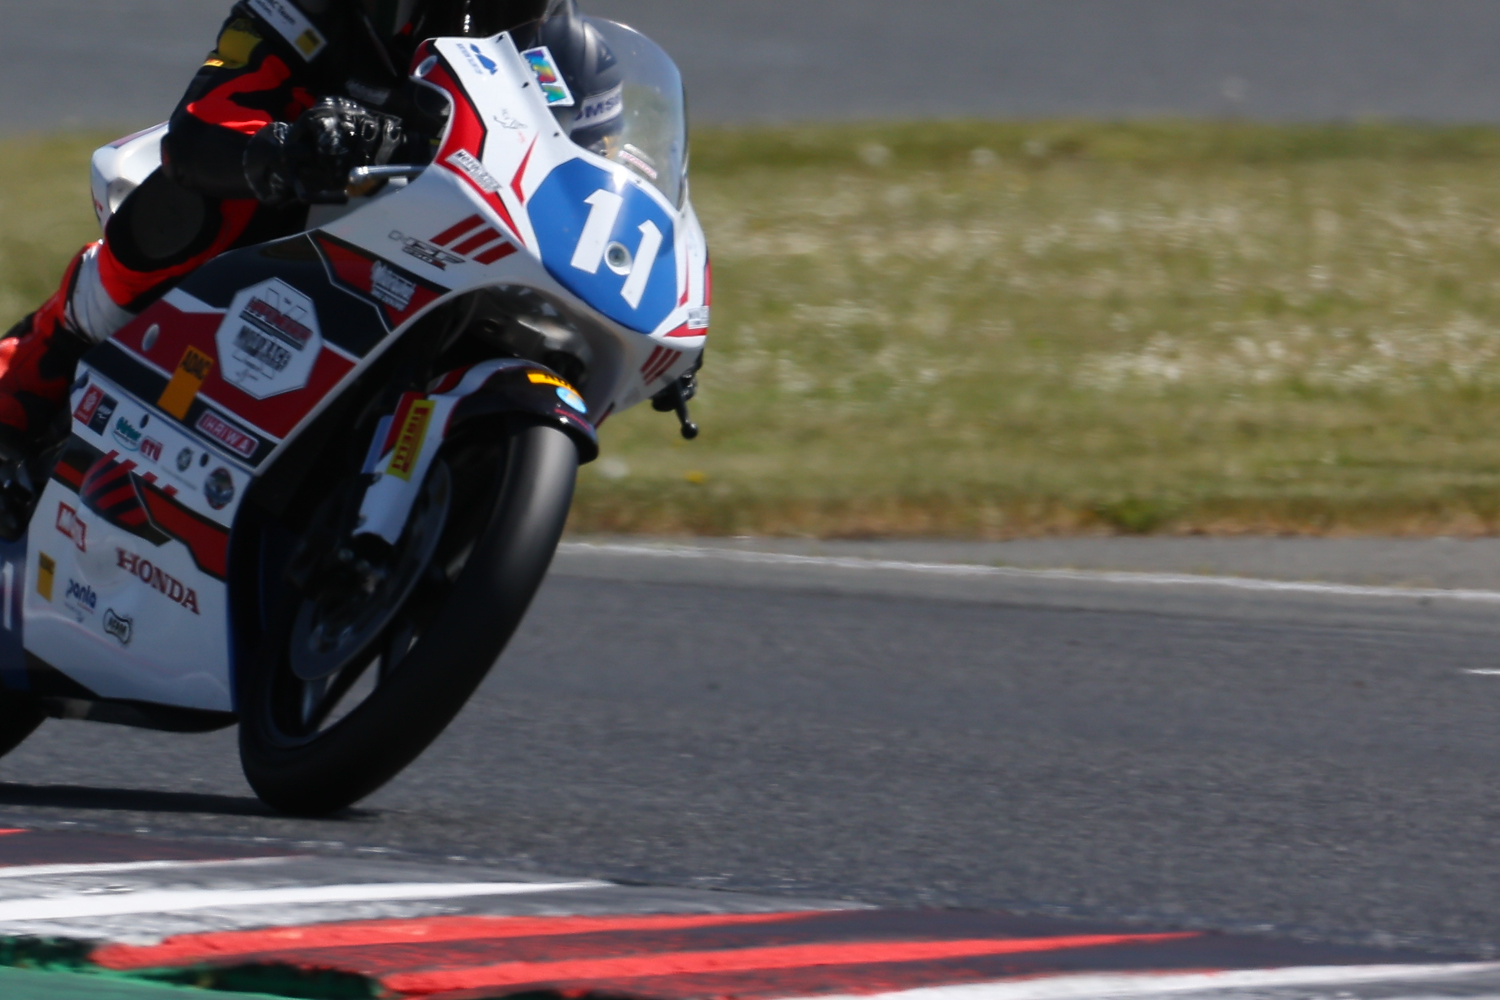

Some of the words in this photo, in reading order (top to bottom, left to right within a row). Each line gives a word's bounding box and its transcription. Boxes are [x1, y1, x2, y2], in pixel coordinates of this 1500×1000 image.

[571, 188, 663, 310] 11
[180, 349, 211, 378] ADAC
[116, 547, 200, 615] HONDA
